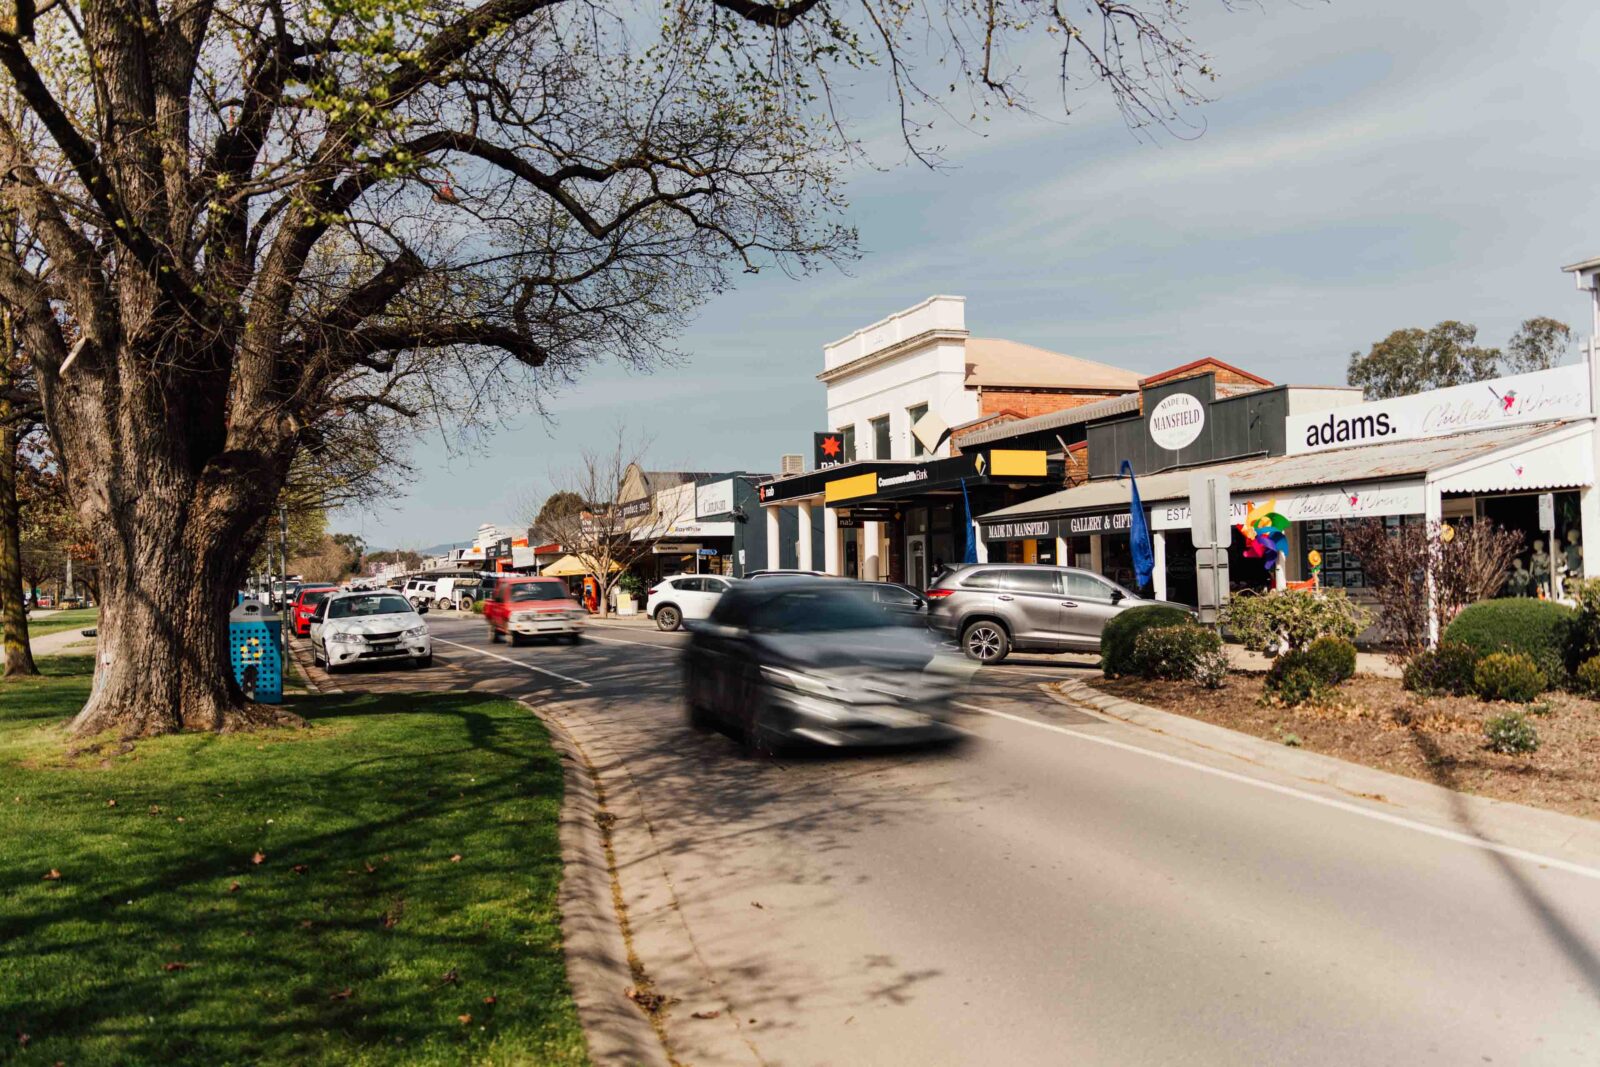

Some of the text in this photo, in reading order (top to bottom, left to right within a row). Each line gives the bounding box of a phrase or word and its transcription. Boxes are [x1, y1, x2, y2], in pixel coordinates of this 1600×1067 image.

[1161, 397, 1189, 409] MADE IN
[1153, 409, 1200, 431] MANSFIELD
[1306, 412, 1397, 447] adams.
[820, 459, 841, 470] nab
[765, 486, 775, 497] nab
[1167, 502, 1254, 521] ESTA ENT
[988, 521, 1049, 538] MADE IN MANSFIELD
[1071, 513, 1132, 533] GALLERY & GIFT
